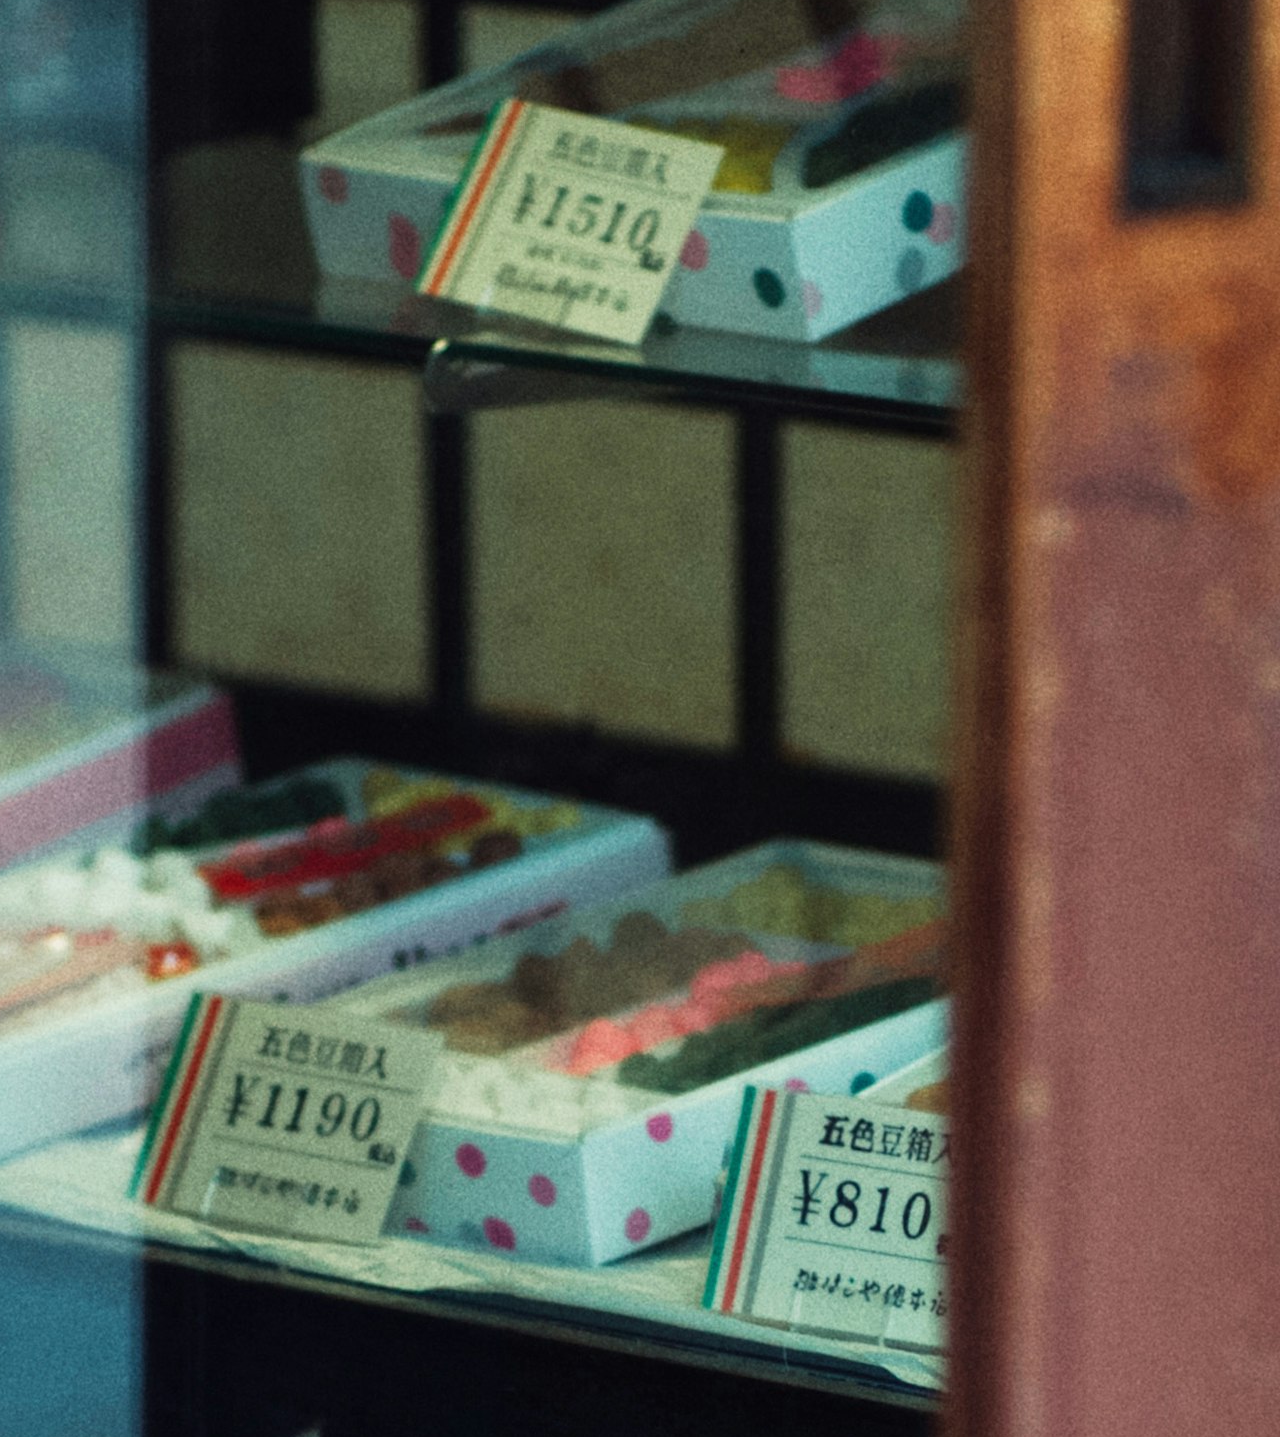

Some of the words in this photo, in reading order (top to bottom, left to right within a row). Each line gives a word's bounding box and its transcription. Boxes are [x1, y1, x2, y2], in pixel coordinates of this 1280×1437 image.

[512, 170, 661, 252] ¥1510
[223, 1072, 382, 1142] ¥1190
[818, 1114, 953, 1165] 五色豆箱入
[792, 1168, 932, 1241] ¥810
